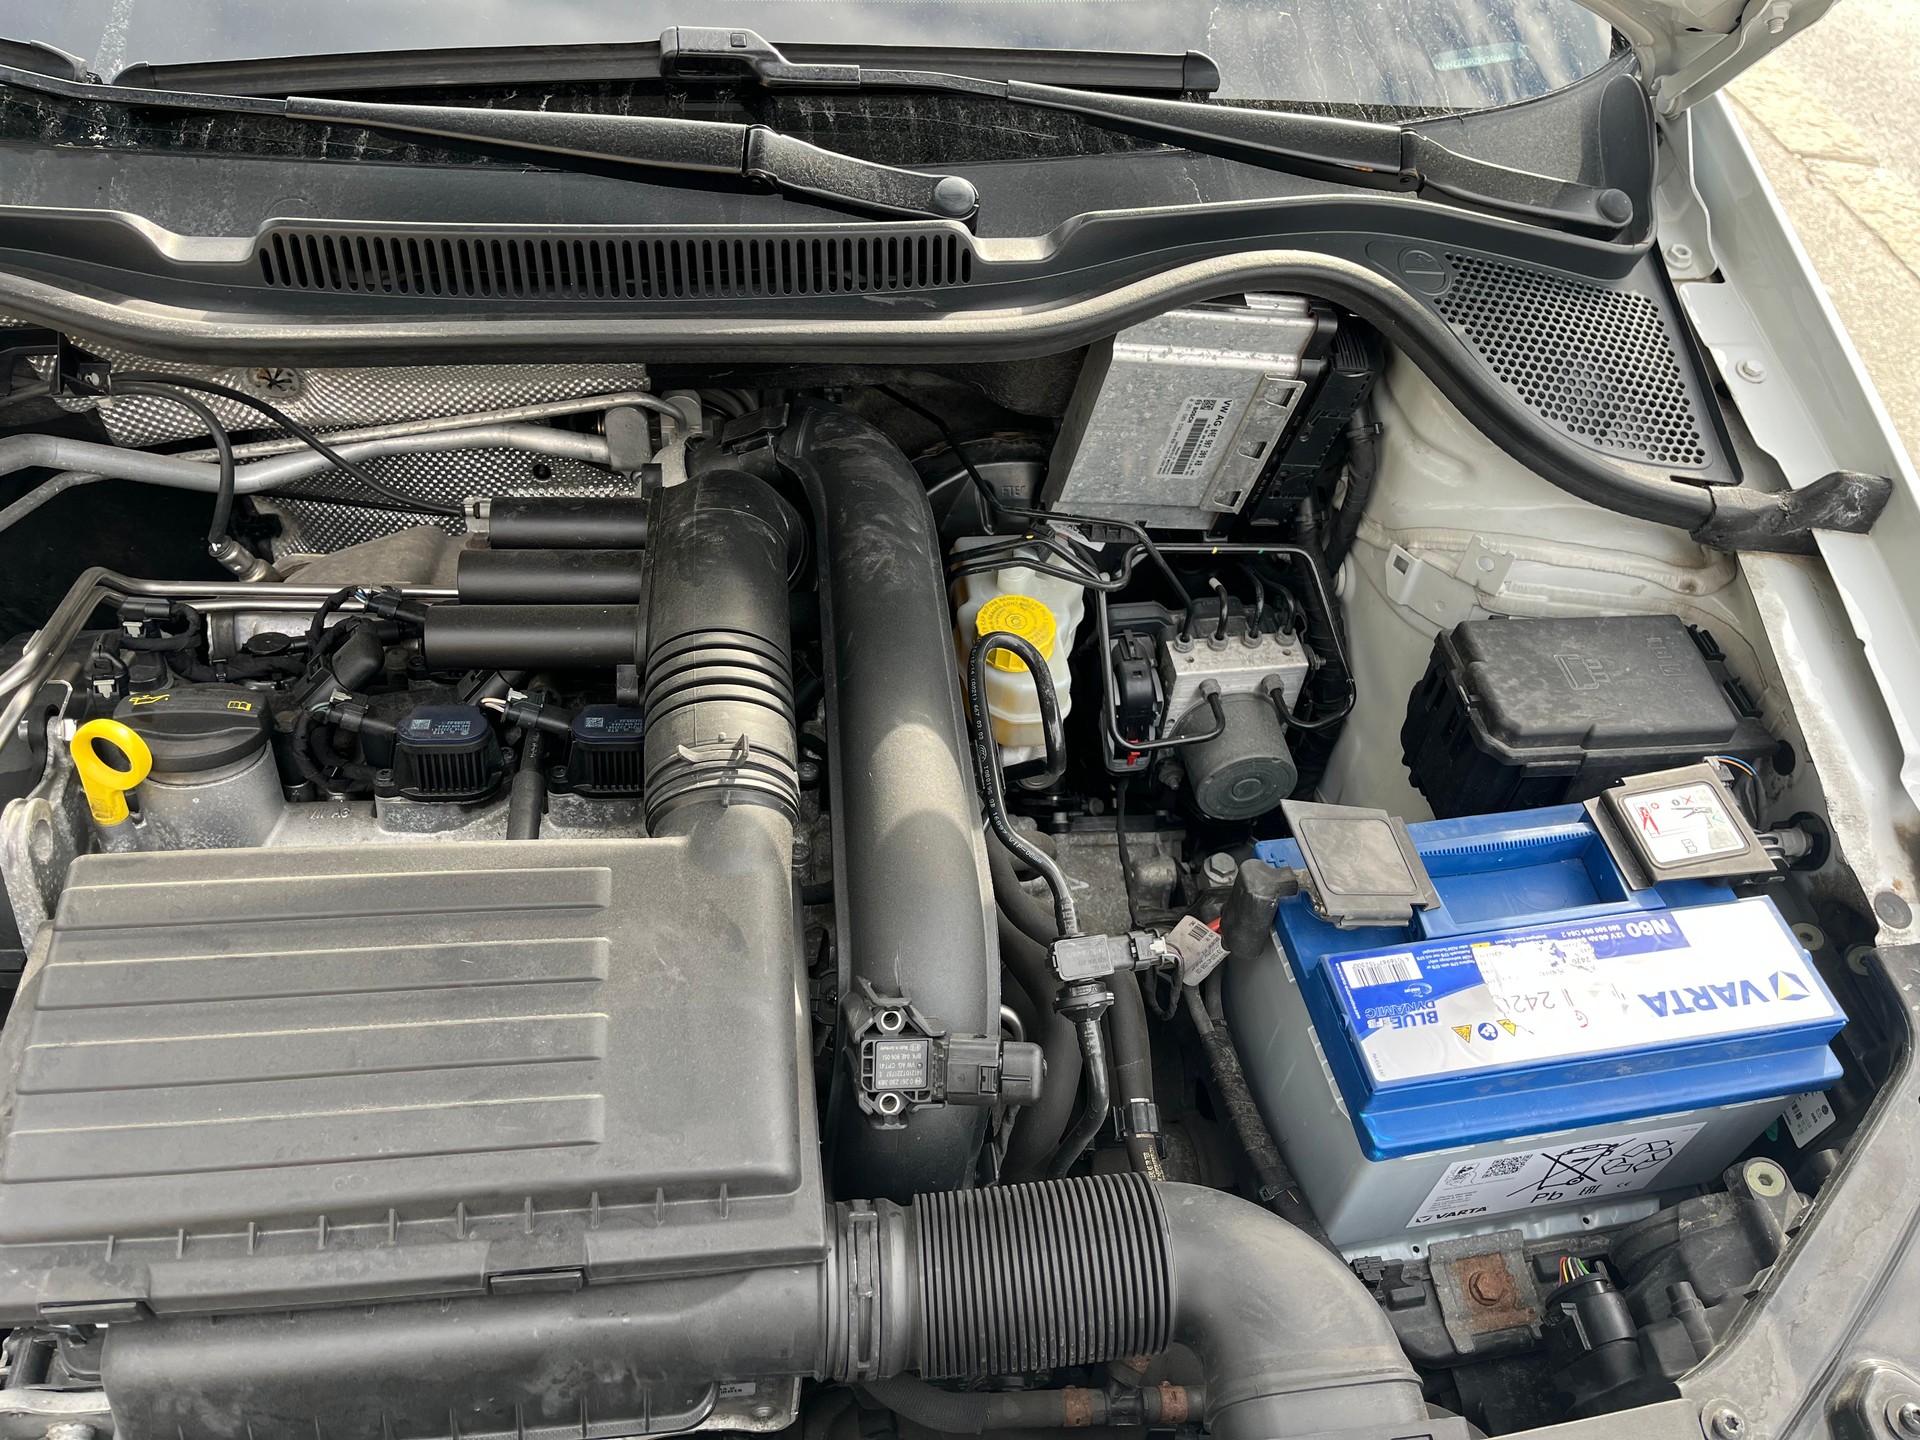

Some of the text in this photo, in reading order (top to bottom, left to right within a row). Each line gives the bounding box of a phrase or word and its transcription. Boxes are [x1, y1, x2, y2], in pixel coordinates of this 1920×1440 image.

[1218, 399, 1232, 413] VW
[1186, 406, 1199, 423] BOSCH
[1212, 414, 1225, 426] AG
[1607, 930, 1625, 939] 12V
[1622, 917, 1673, 938] N60
[1636, 978, 1770, 1018] VARTA
[1362, 998, 1436, 1018] DYNAMIC
[1386, 1009, 1441, 1029] BLUE
[1527, 1188, 1569, 1204] Pb
[1431, 1204, 1491, 1220] VARTA
